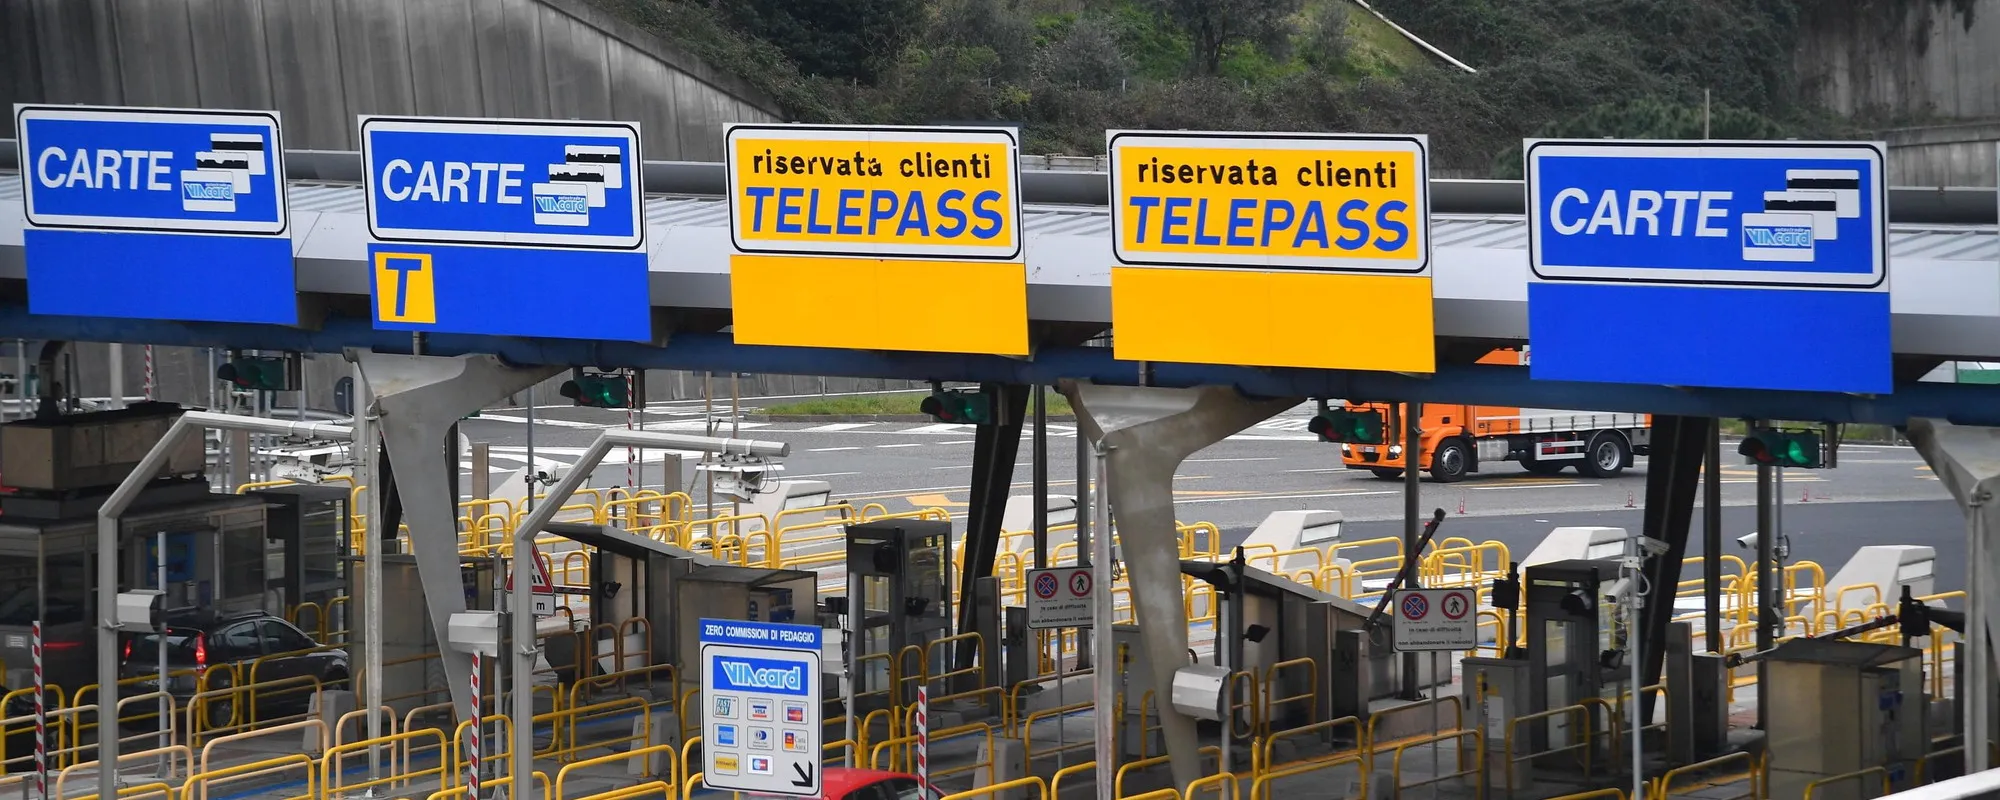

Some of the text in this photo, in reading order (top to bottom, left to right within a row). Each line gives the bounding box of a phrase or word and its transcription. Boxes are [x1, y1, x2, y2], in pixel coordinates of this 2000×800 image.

[38, 146, 174, 191] CARTE
[753, 148, 990, 179] riservata clienti
[1138, 156, 1396, 189] riservata clienti
[184, 183, 233, 200] VIAcard
[382, 158, 525, 205] CARTE
[535, 196, 587, 214] VIAcard
[747, 187, 1003, 239] TELEPASS
[1550, 187, 1733, 237] CARTE
[1130, 196, 1409, 251] TELEPASS
[1745, 228, 1811, 247] VIAcard
[385, 258, 422, 316] T
[536, 602, 545, 610] m
[705, 624, 815, 643] ZERO COMMISSIONI DI PEDAGGIO
[721, 660, 801, 691] VIAcard
